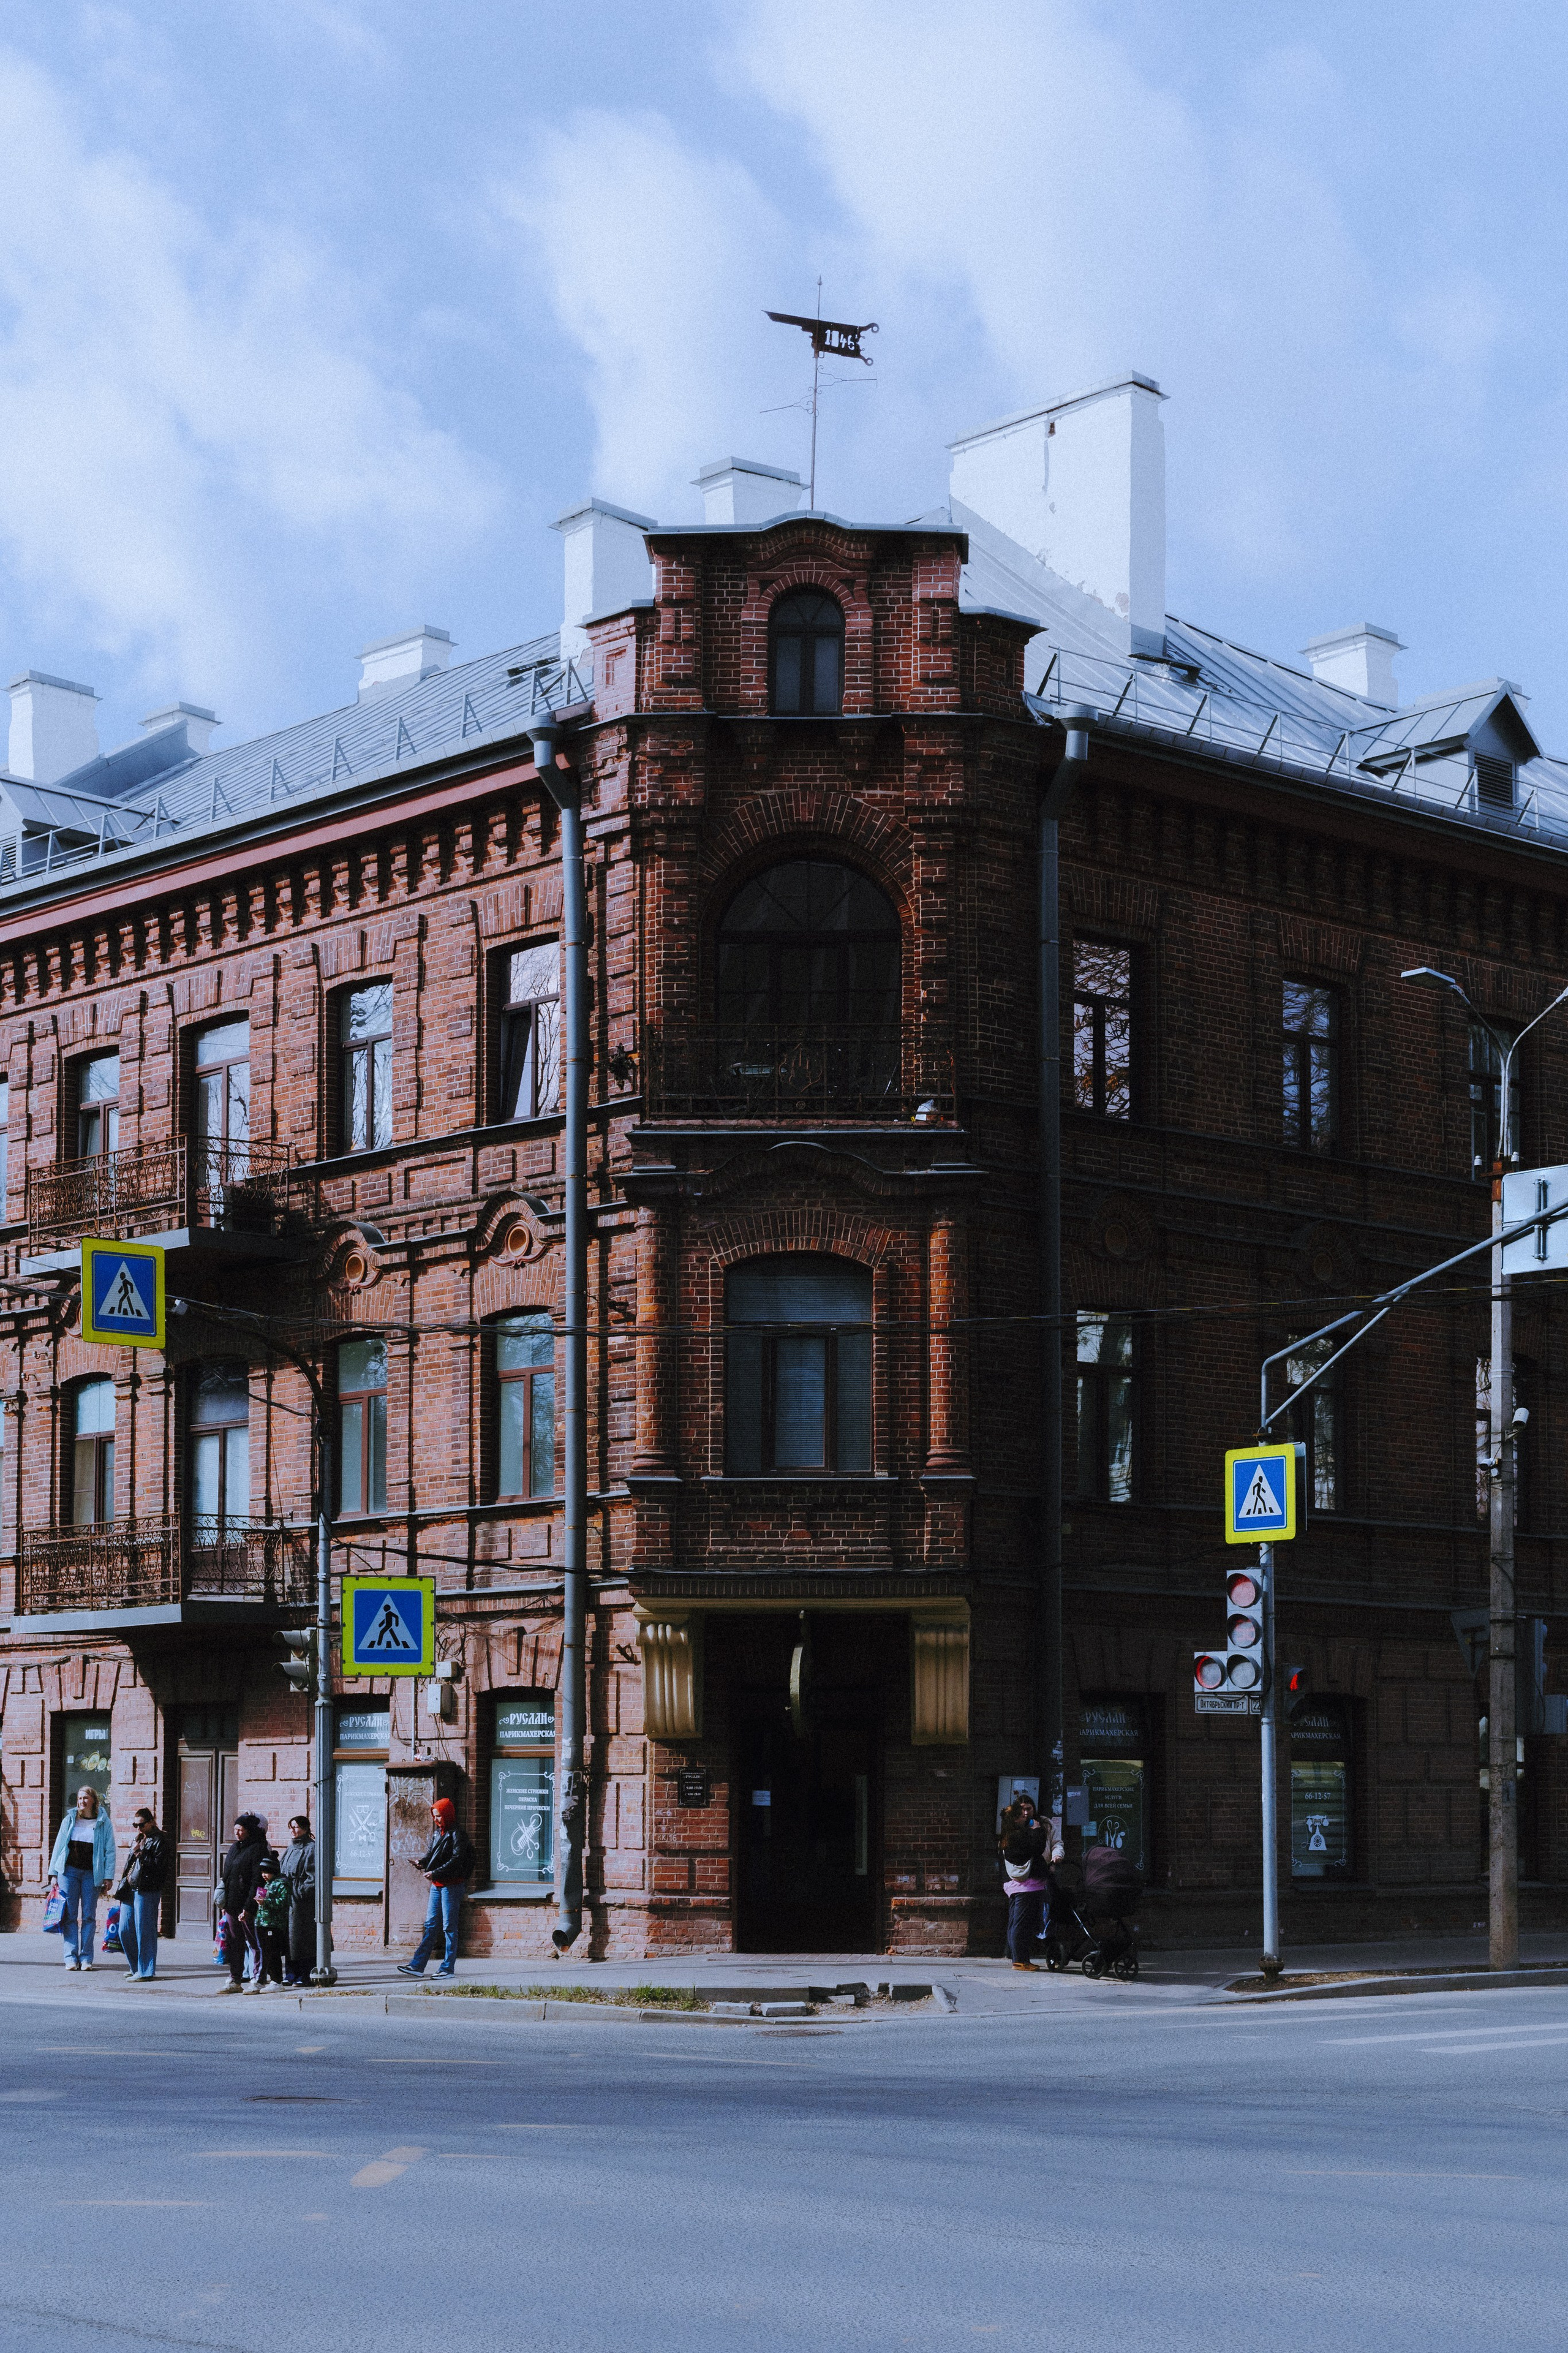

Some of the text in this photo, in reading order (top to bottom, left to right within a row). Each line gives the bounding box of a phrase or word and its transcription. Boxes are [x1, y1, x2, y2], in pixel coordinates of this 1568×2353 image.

[349, 1716, 382, 1728] РУСЛАН
[509, 1712, 548, 1725] РУСЛАН
[85, 1729, 109, 1740] ИГРЫ
